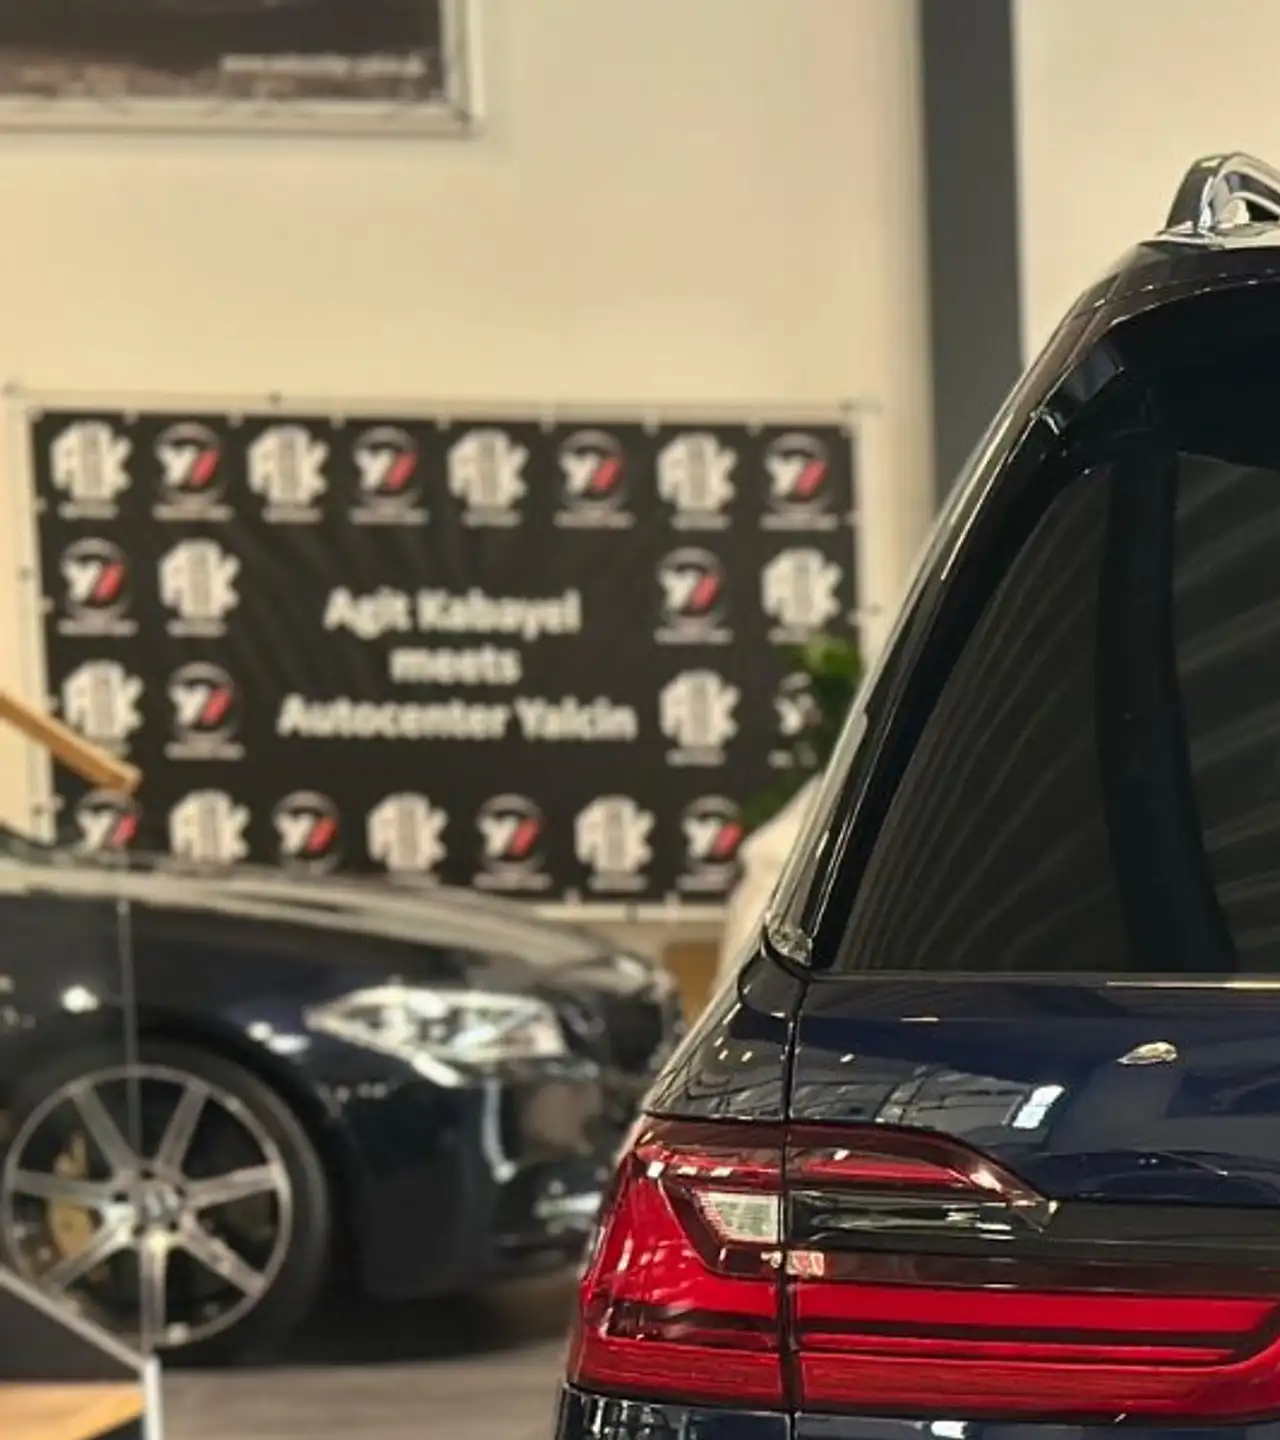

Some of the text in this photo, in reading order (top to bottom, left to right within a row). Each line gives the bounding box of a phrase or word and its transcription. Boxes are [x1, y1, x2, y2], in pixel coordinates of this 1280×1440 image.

[323, 585, 412, 640] Agit
[388, 643, 523, 685] meets
[276, 692, 512, 741] Autocenter
[513, 695, 639, 742] Yalcin
